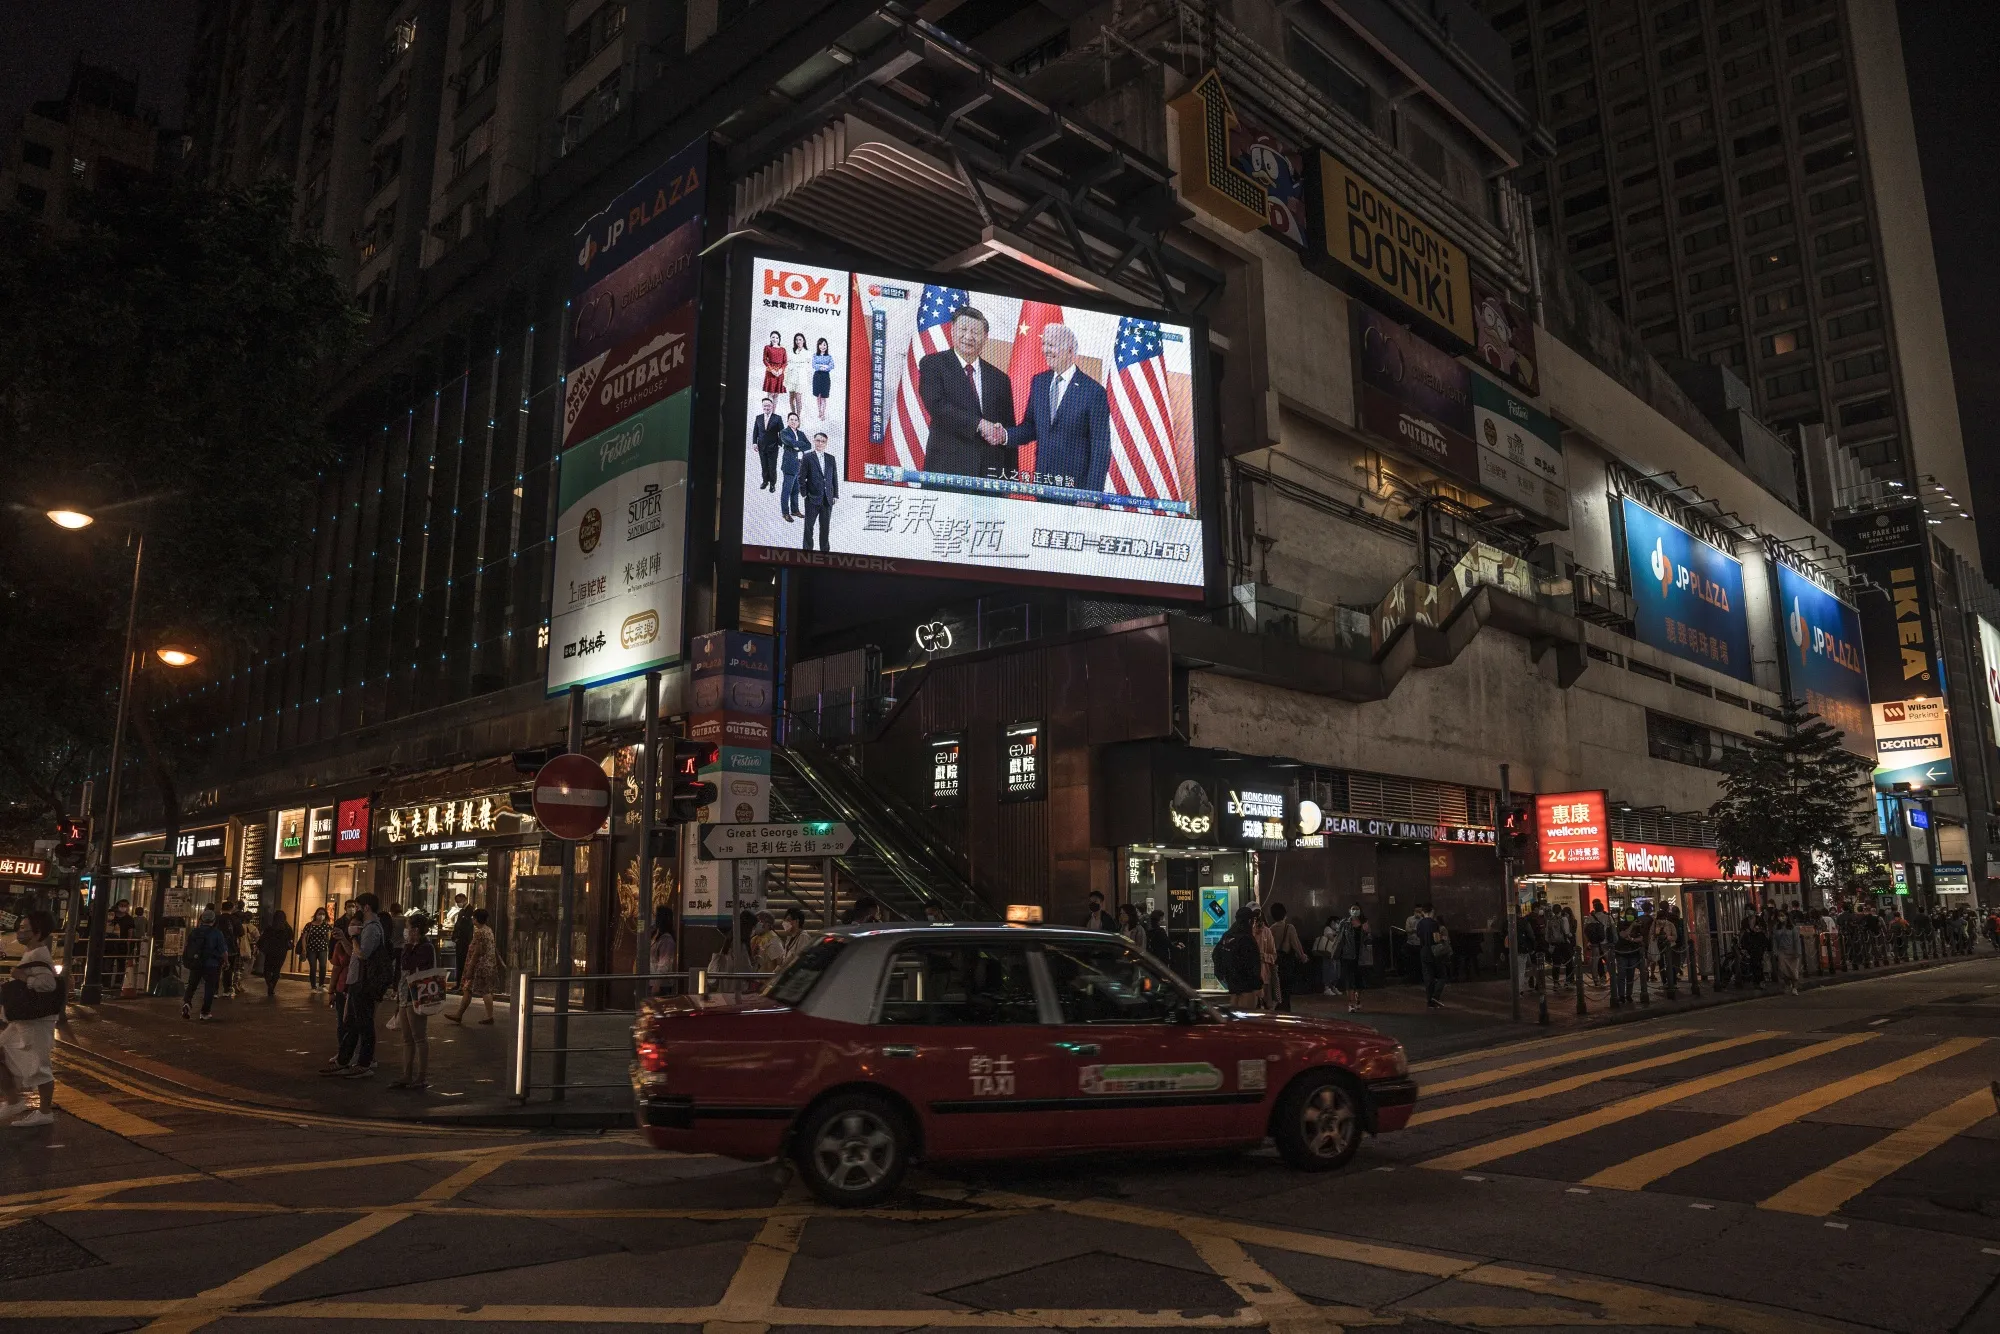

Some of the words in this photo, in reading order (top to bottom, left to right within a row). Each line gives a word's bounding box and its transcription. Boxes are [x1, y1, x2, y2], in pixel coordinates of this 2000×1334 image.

[601, 218, 625, 253] JP
[628, 166, 700, 235] PLAZA
[1345, 176, 1394, 237] DON
[1397, 213, 1440, 269] DON
[1348, 211, 1454, 326] DONKI
[620, 272, 664, 310] CINEMA
[665, 250, 694, 280] CITY
[763, 269, 829, 302] HOY
[823, 292, 841, 304] TV
[600, 341, 686, 406] OUTBACK
[567, 366, 586, 408] NOW
[615, 382, 664, 413] STEAKHOUSE
[1399, 420, 1448, 457] OUTBACK
[987, 467, 1075, 488] 二人之後正式會談
[628, 493, 662, 525] SUPER
[1858, 532, 1871, 540] THE
[1872, 527, 1890, 538] PARK
[1892, 525, 1910, 535] LANE
[1032, 528, 1190, 561] 逢星期一至五晚上6時
[623, 552, 662, 585] 米線陣
[759, 549, 790, 562] JM
[796, 550, 897, 572] NETWORK
[1675, 563, 1690, 591] JP
[1690, 570, 1730, 613] PLAZA
[1890, 566, 1928, 681] IKEA
[1812, 625, 1825, 656] JP
[1825, 631, 1862, 674] PLAZA
[729, 658, 739, 666] JP
[1907, 703, 1938, 711] Wilson
[1908, 712, 1939, 720] Parking
[692, 725, 720, 737] OUTBACK
[726, 725, 768, 737] OUTBACK
[1024, 744, 1035, 755] JP
[1880, 737, 1939, 750] DECATHLON
[948, 753, 958, 763] JP
[1009, 756, 1035, 774] 戲院
[935, 764, 958, 779] 戲院
[1228, 797, 1283, 818] EXCHANGE
[1241, 791, 1263, 802] HONG
[1264, 793, 1282, 804] KONG
[1552, 803, 1590, 824] 惠康
[341, 829, 360, 840] TUDOR
[727, 828, 756, 838] Great
[761, 827, 798, 838] George
[803, 827, 835, 836] Street
[1326, 817, 1362, 833] PEARL
[1369, 820, 1395, 836] CITY
[1400, 823, 1447, 841] MANSION
[1547, 826, 1598, 837] wellcome
[284, 837, 300, 847] ROLEX
[747, 841, 816, 854] 記利佐治街
[1295, 835, 1323, 847] CHANGE
[1549, 849, 1566, 863] 24
[1626, 848, 1675, 873] wellcome
[15, 861, 43, 876] FULL
[969, 1055, 1015, 1074] 的士
[969, 1075, 1016, 1096] TAXI
